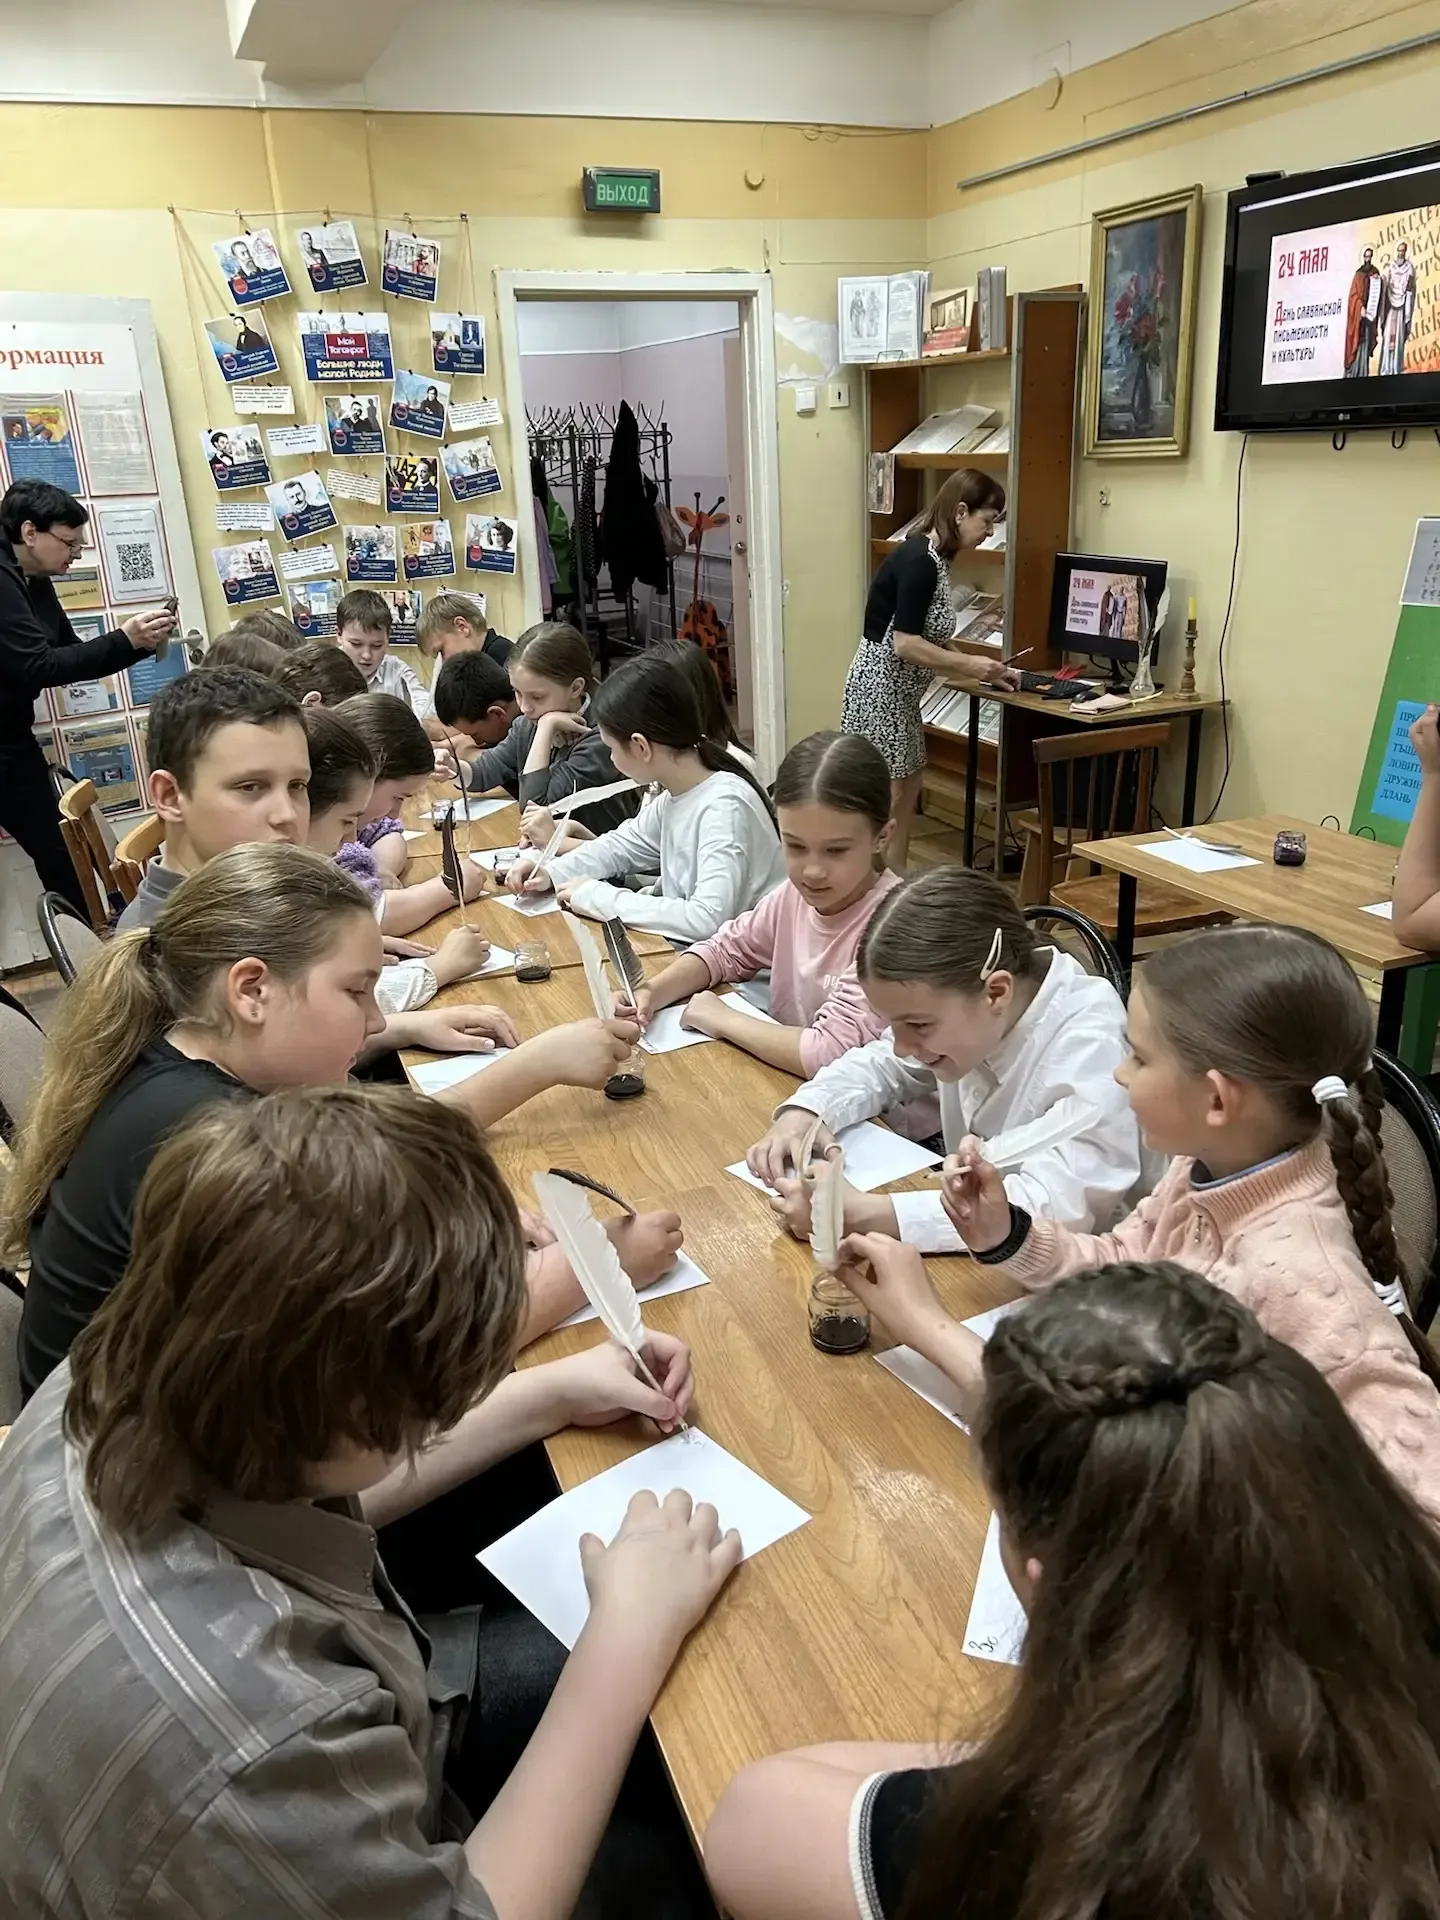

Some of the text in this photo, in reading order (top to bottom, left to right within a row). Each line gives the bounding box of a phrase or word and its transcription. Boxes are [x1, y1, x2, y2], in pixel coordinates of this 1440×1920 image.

[597, 183, 648, 204] ВЫХОД
[1279, 246, 1328, 279] 24 МАЯ
[337, 336, 355, 345] Мой
[328, 346, 366, 356] Таганрог
[316, 360, 384, 368] Большие люди
[317, 369, 385, 378] малой Родины
[1379, 788, 1411, 804] ДЛАНЬ
